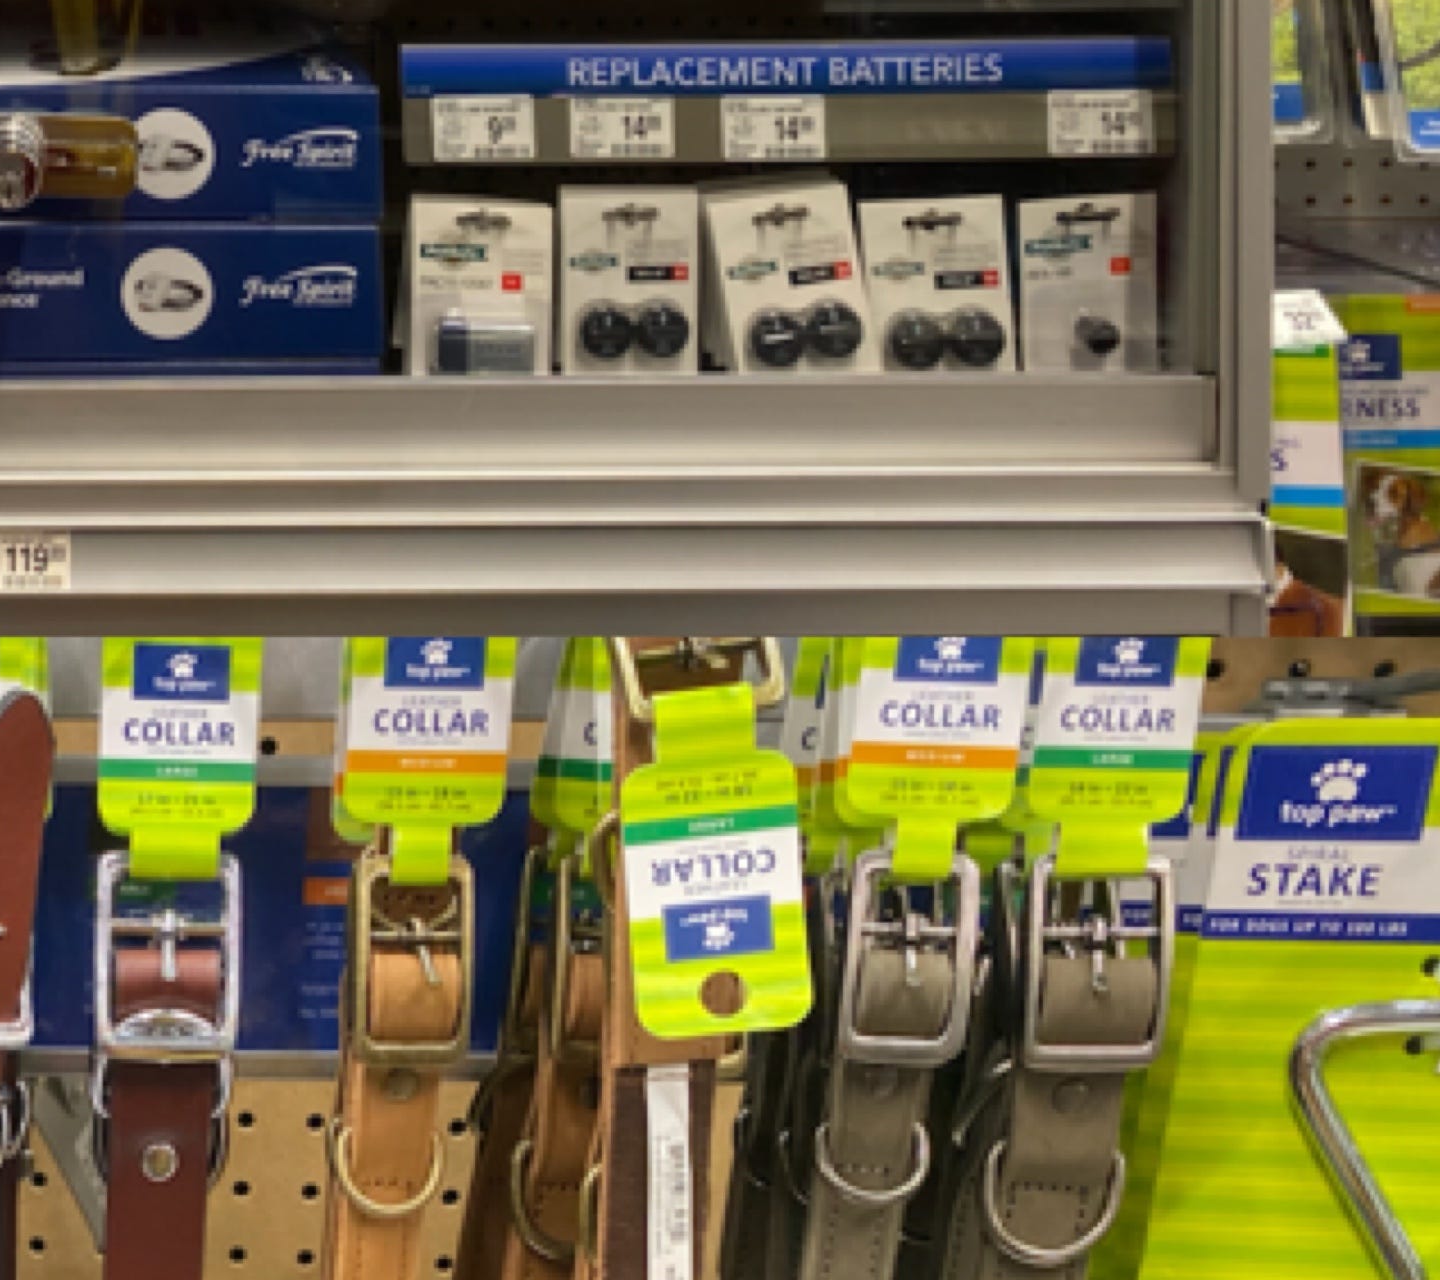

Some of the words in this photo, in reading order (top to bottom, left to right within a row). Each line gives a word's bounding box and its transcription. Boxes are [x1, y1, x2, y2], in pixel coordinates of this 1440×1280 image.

[569, 57, 817, 88] REPLACEMENT
[827, 54, 1004, 85] BATTERIES
[373, 708, 490, 737] COLLAR
[879, 699, 1001, 729] COLLAR
[1060, 705, 1176, 733] COLLAR
[123, 717, 236, 748] COLLAR
[1279, 800, 1325, 827] top
[1328, 803, 1384, 829] paw
[651, 849, 777, 887] COLLAR
[1246, 862, 1383, 897] STAKE
[1210, 917, 1240, 932] FOR
